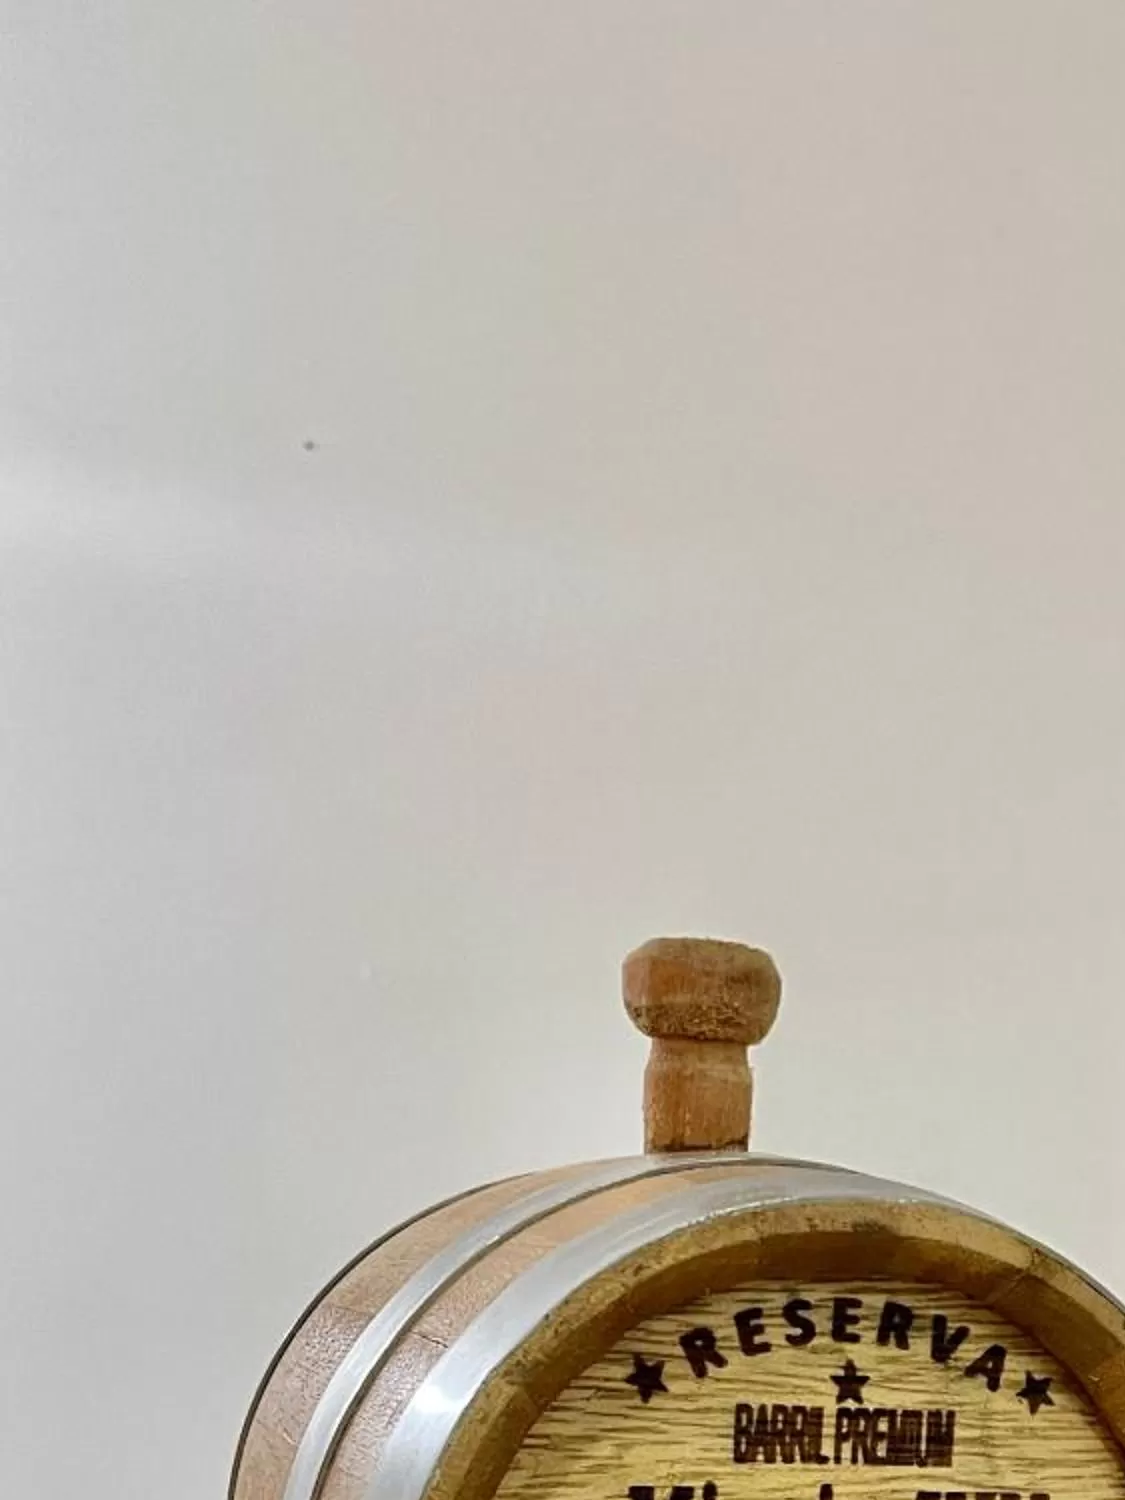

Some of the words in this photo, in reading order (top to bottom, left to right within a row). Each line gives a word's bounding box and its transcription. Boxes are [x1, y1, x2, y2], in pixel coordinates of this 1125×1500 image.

[680, 1297, 1006, 1391] RESERVA
[733, 1403, 829, 1464] BARRIL
[834, 1407, 955, 1468] PREMIUM
